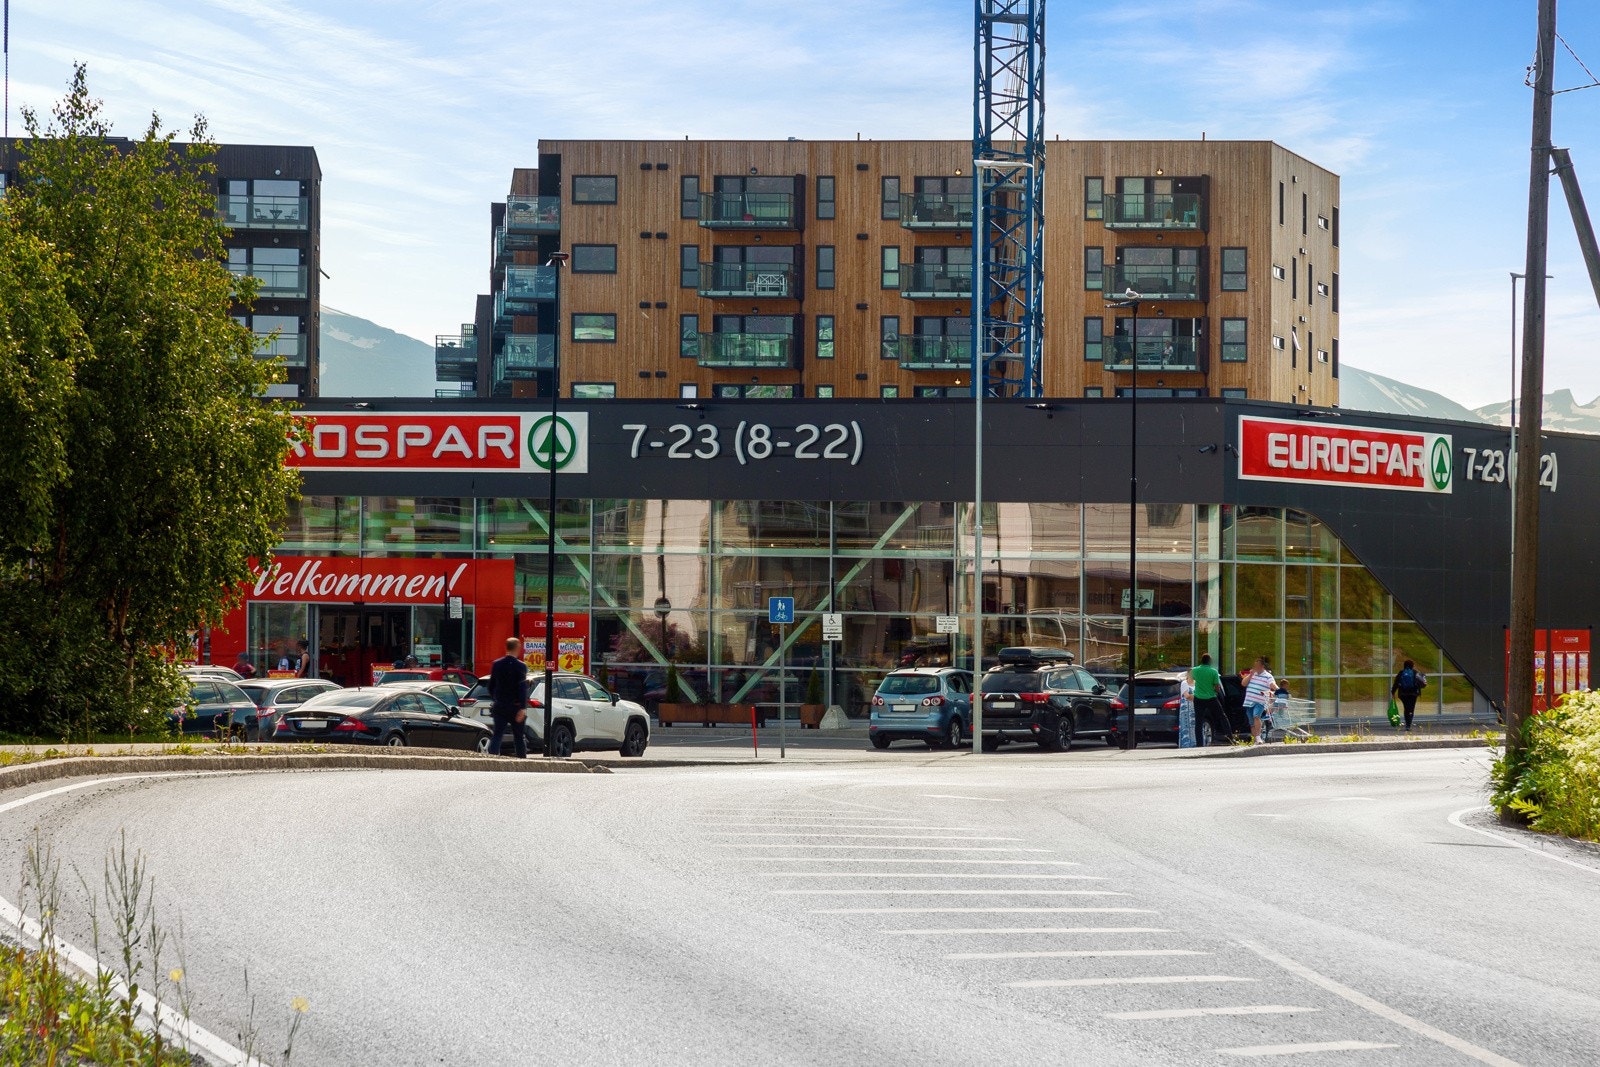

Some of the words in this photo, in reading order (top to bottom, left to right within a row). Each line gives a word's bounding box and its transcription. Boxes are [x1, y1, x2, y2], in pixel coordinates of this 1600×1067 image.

[622, 423, 721, 459] 7-23
[735, 420, 863, 466] (8-22)
[1267, 432, 1425, 479] EUROSPAR
[1463, 447, 1505, 483] 7-23
[253, 559, 468, 598] Velkommen!
